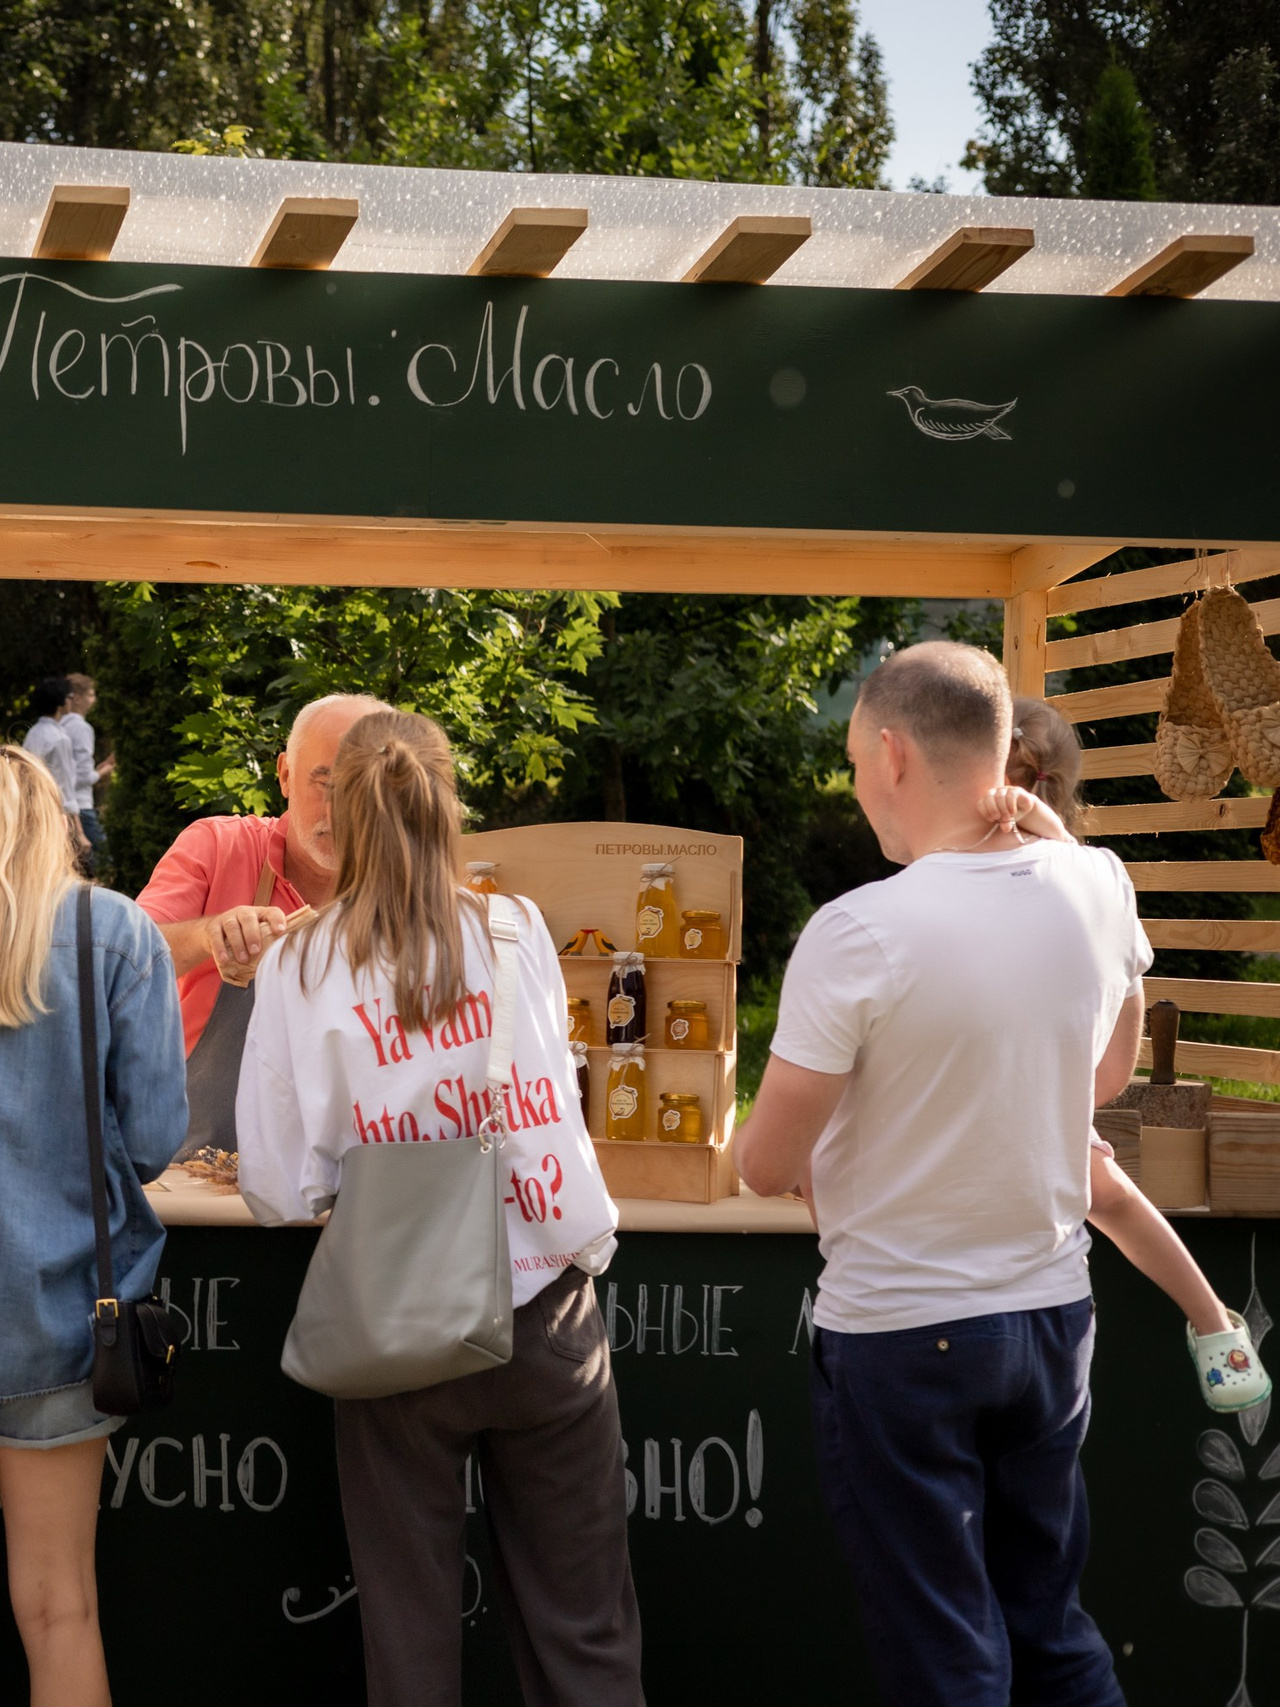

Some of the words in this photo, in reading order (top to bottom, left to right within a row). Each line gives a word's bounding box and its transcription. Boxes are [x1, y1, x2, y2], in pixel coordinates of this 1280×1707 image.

[406, 300, 712, 421] Масло
[595, 843, 717, 856] ПЕТРОВЫ.МАСЛО
[352, 998, 413, 1067] Ya
[98, 1432, 288, 1513] УСНО
